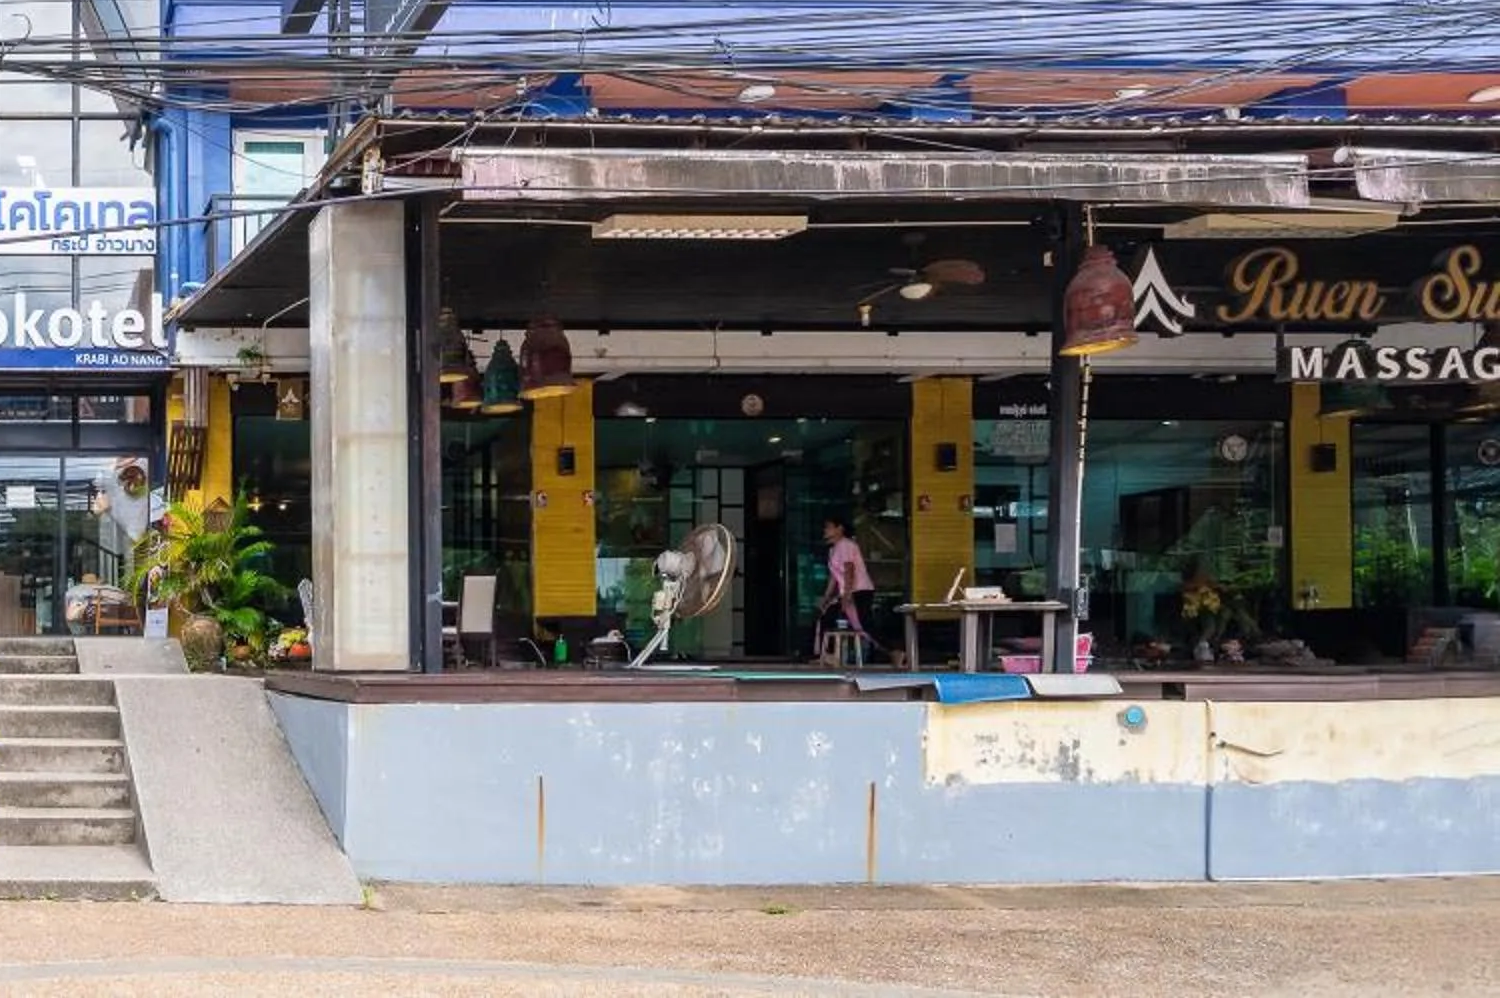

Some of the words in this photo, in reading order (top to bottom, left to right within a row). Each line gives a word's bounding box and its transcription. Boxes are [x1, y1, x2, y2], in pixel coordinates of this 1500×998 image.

[1217, 245, 1385, 322] Ruen
[75, 353, 108, 365] KRABI
[132, 355, 163, 366] NANG
[1291, 347, 1500, 379] MASSAG
